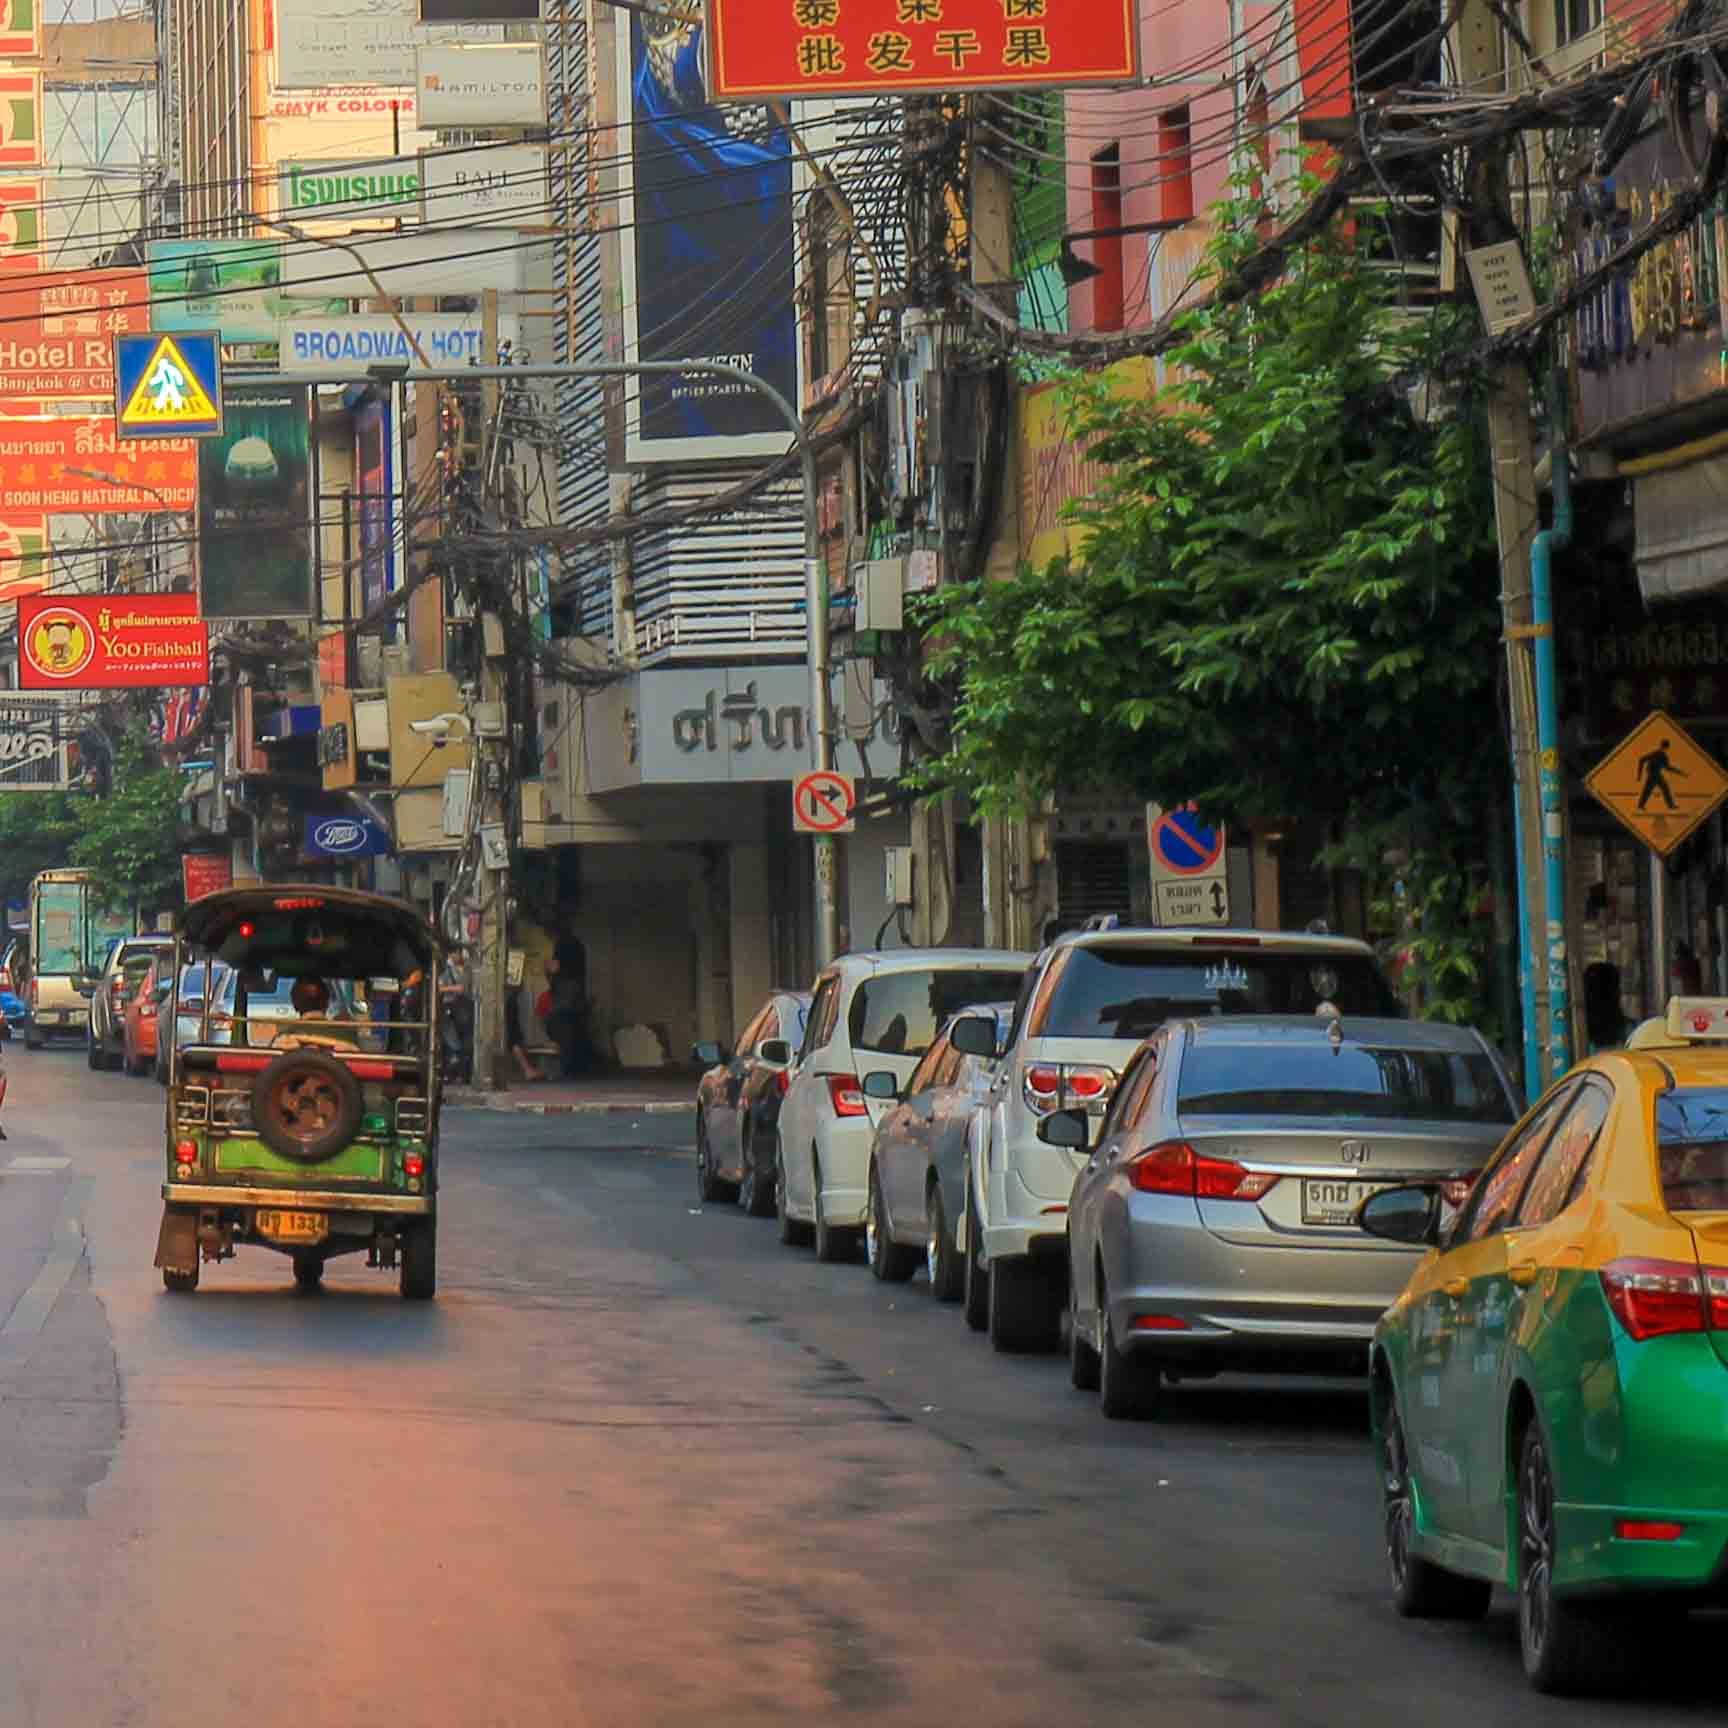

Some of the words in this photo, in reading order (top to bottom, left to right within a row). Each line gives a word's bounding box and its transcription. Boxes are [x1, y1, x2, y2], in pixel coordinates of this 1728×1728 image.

[799, 28, 1050, 76] 批发干果
[294, 330, 422, 361] BROADWAY
[43, 489, 79, 506] HENG
[100, 635, 142, 658] Yoo
[143, 640, 203, 658] Fishball
